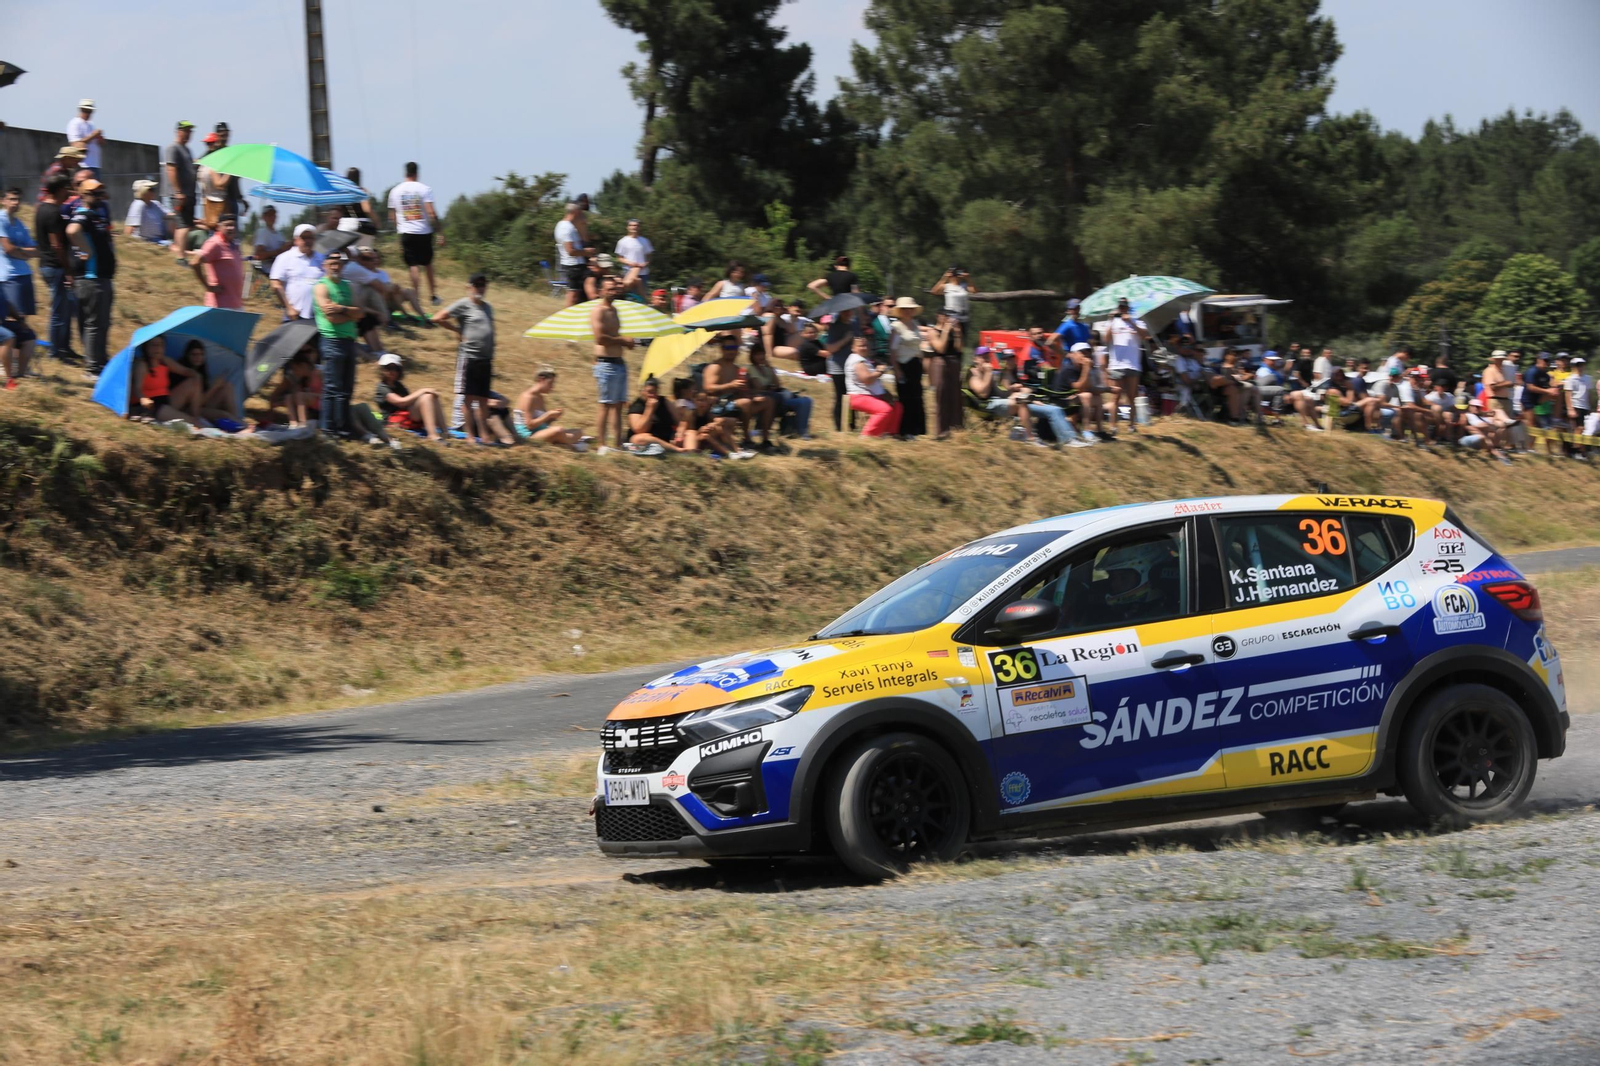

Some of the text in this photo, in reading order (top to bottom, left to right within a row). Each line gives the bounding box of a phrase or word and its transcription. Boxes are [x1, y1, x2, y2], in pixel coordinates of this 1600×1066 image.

[1298, 518, 1347, 555] 36
[1433, 527, 1462, 540] AON
[1229, 563, 1316, 585] K.Santana
[1235, 578, 1339, 603] J.Hernandez
[1444, 592, 1468, 613] FCA
[1241, 623, 1341, 647] GRUPO ESCARCHÓN
[993, 651, 1037, 682] 36
[1039, 652, 1069, 667] La
[823, 669, 938, 698] Serveis Integrals
[838, 665, 869, 679] Xavi
[765, 679, 794, 691] RACC
[1024, 686, 1062, 702] Recalvi
[1250, 681, 1385, 720] COMPETICIÓN
[1030, 705, 1088, 722] recoletas salud
[1079, 686, 1245, 749] SÁNDEZ
[700, 730, 762, 758] KUMHO
[1269, 745, 1330, 776] RACC
